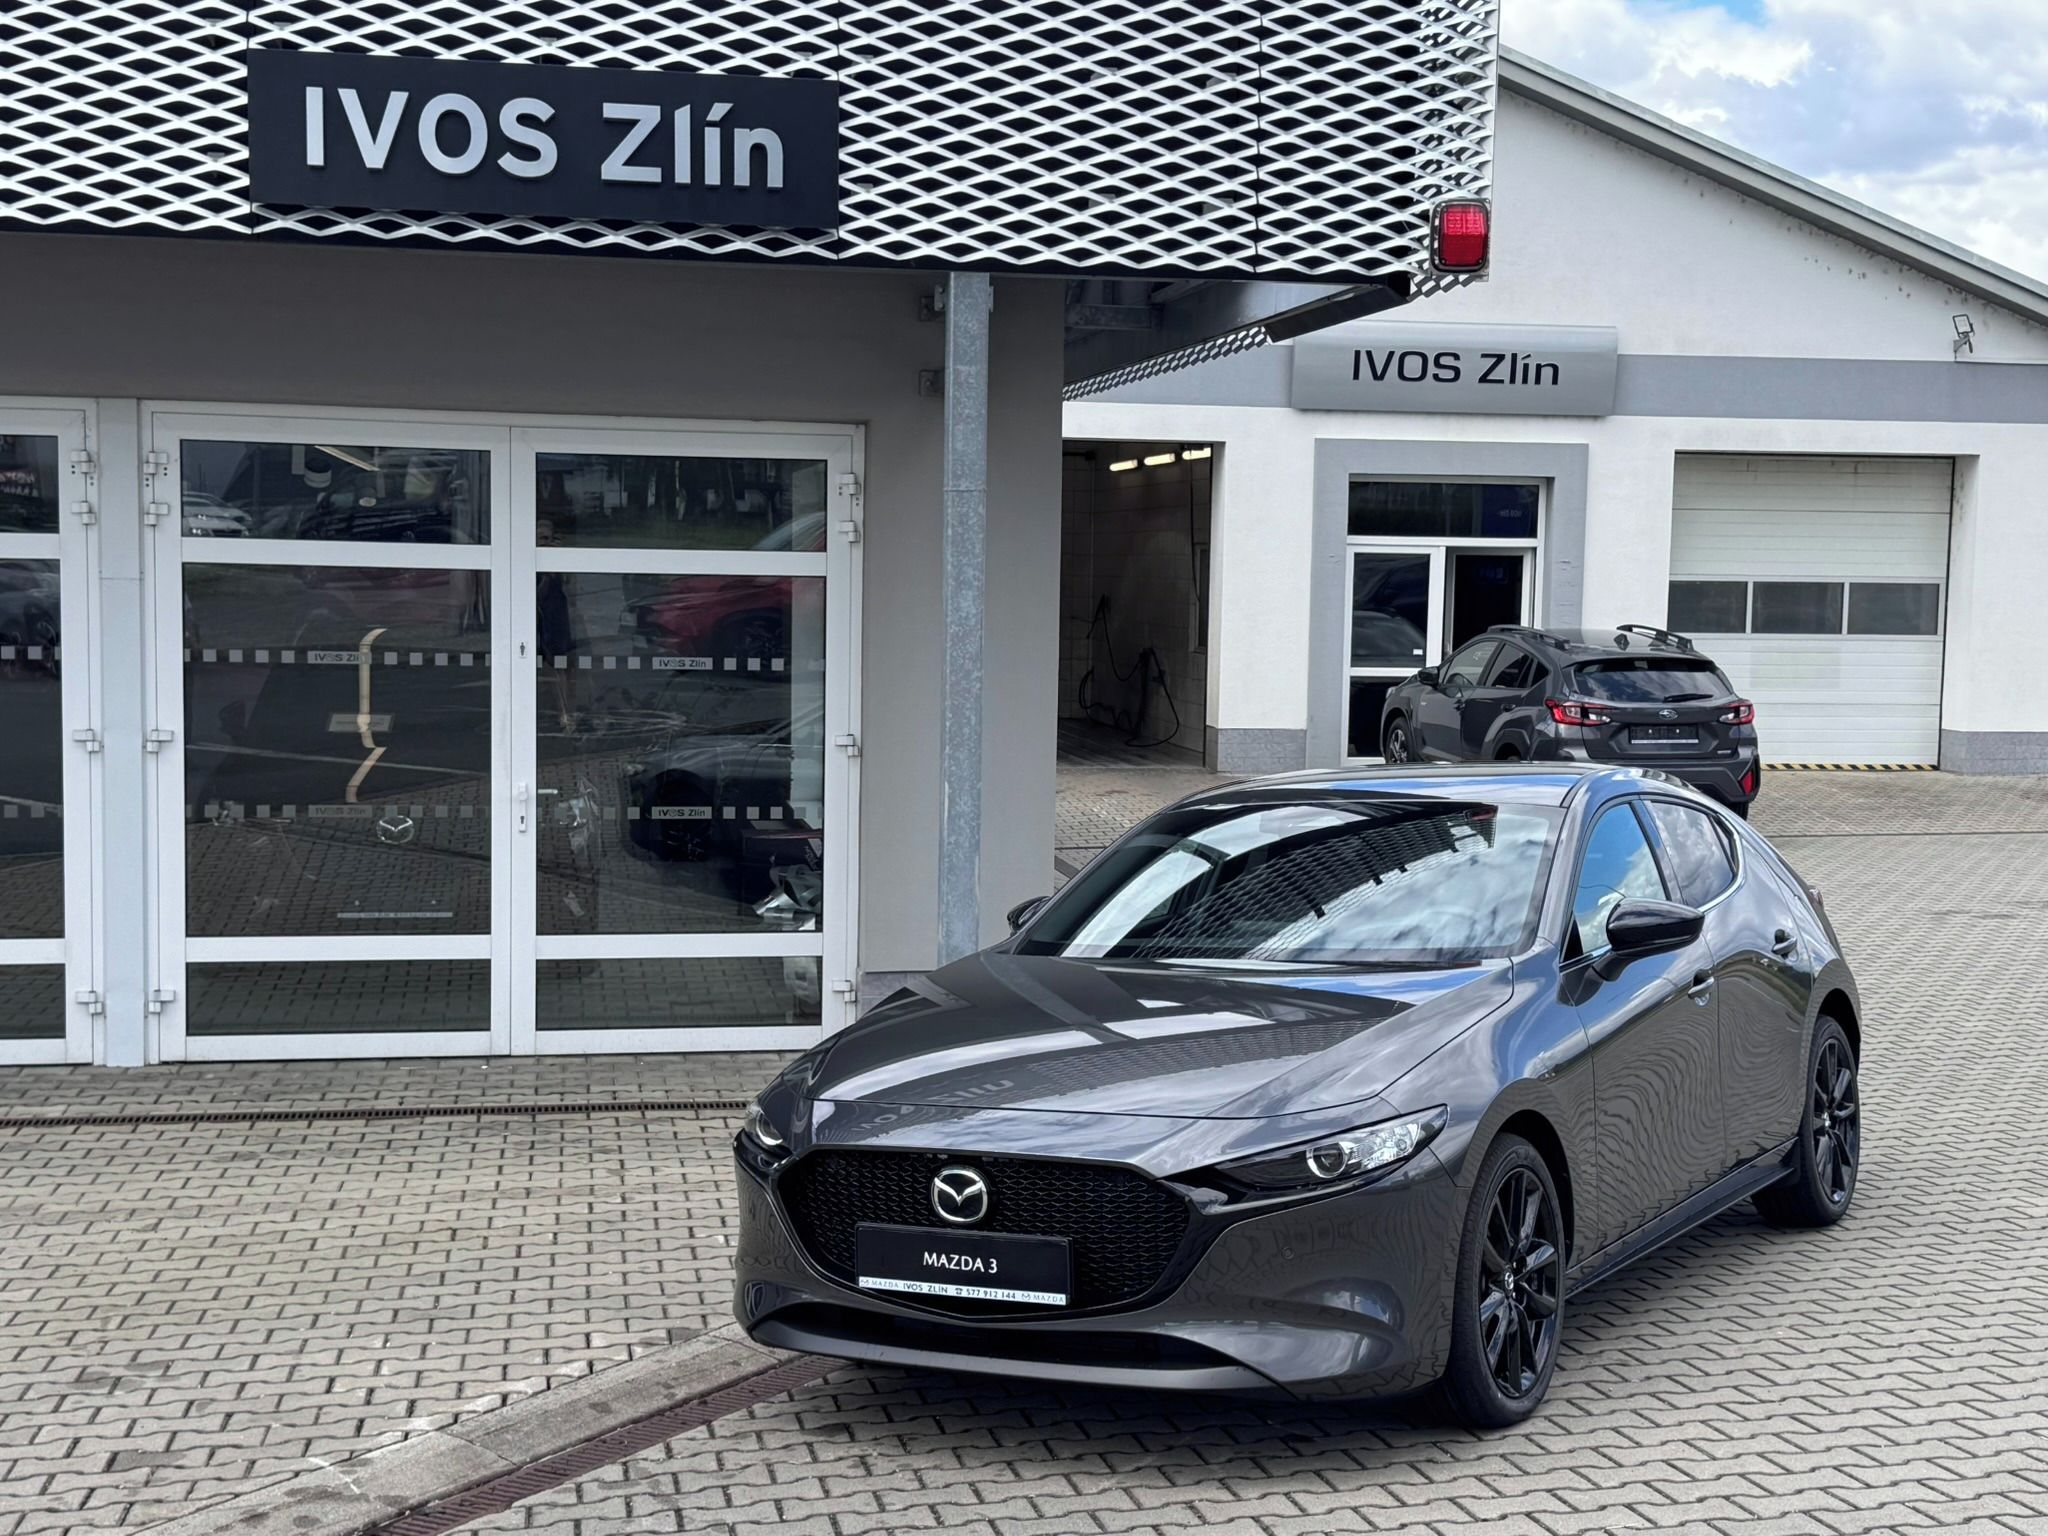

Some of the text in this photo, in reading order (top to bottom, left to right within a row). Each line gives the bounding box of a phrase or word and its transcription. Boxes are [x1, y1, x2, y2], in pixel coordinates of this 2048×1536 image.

[305, 86, 785, 189] IVOS Zlín
[1352, 350, 1560, 386] IVOS Zlín
[922, 1251, 998, 1274] MAZDA 3
[871, 1280, 899, 1289] MAZDA
[903, 1282, 924, 1292] IVOS
[966, 1288, 980, 1297] 577
[983, 1289, 998, 1298] 912
[1001, 1291, 1016, 1300] 144
[1033, 1294, 1064, 1304] MAZDA
